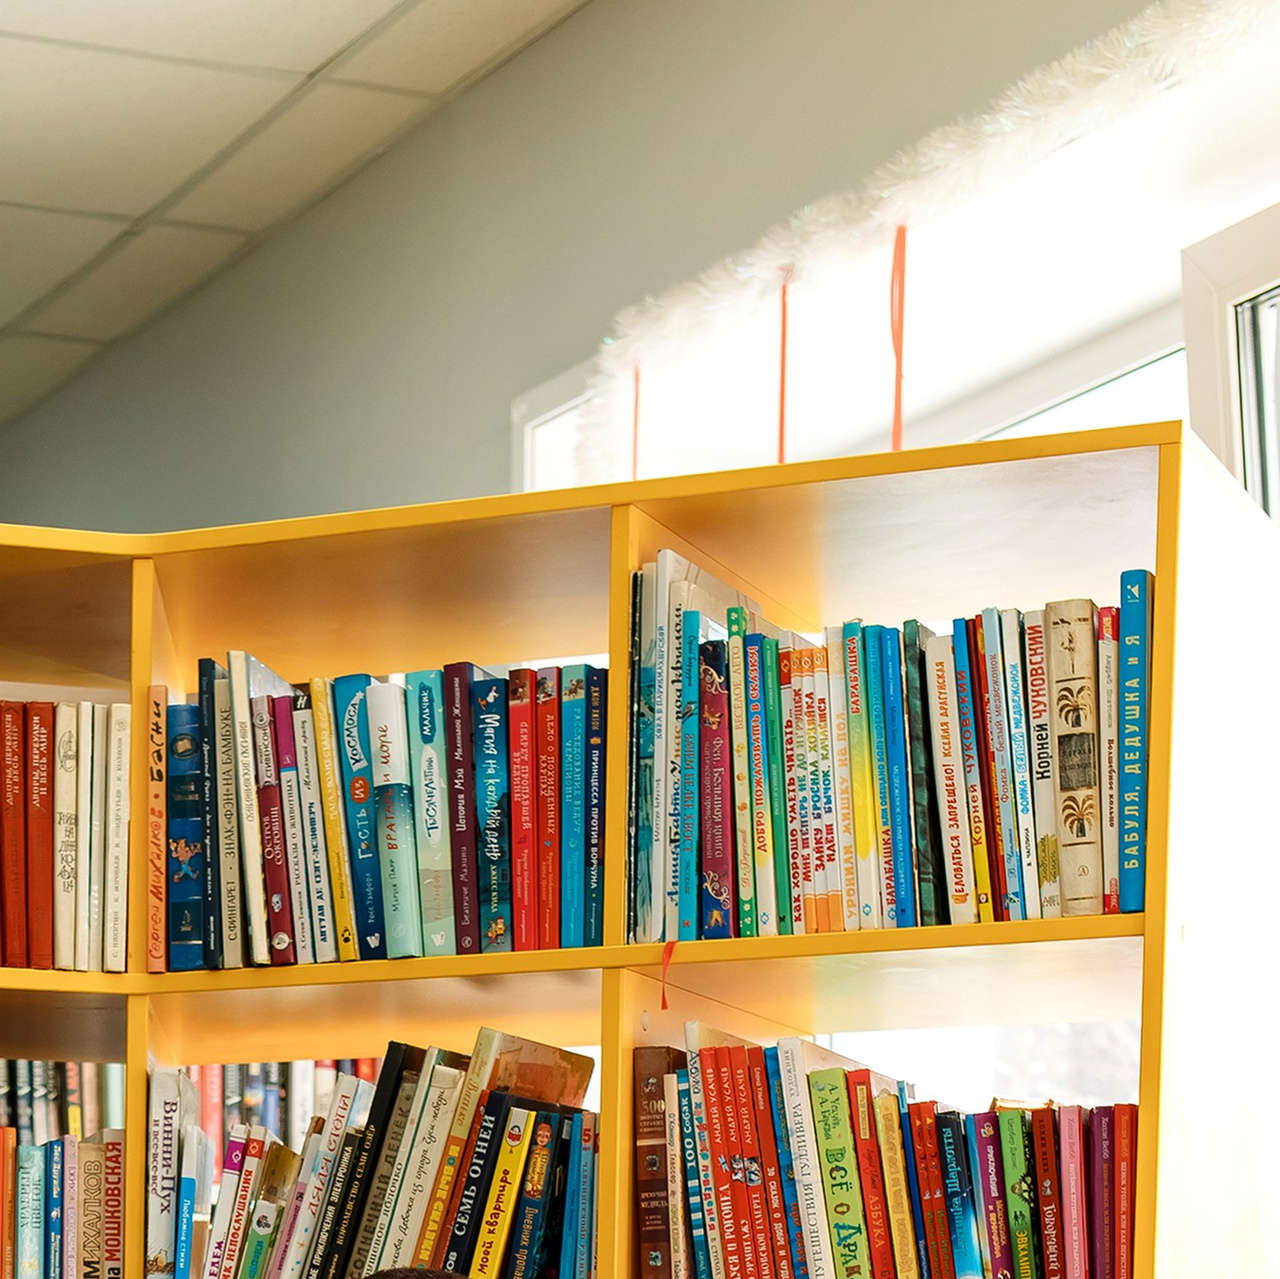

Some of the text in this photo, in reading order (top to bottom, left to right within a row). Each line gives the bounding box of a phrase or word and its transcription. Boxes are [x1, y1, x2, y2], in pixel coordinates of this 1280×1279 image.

[1027, 624, 1052, 780] Корней ЧУКОВСКИЙ
[1124, 679, 1141, 774] ДЕДУШКА
[452, 1113, 496, 1236] СЕМЬ ОГНЕЙ
[793, 1102, 811, 1176] ГУЛЛИВЕРА
[104, 1142, 121, 1261] МОШКОВСКАЯ
